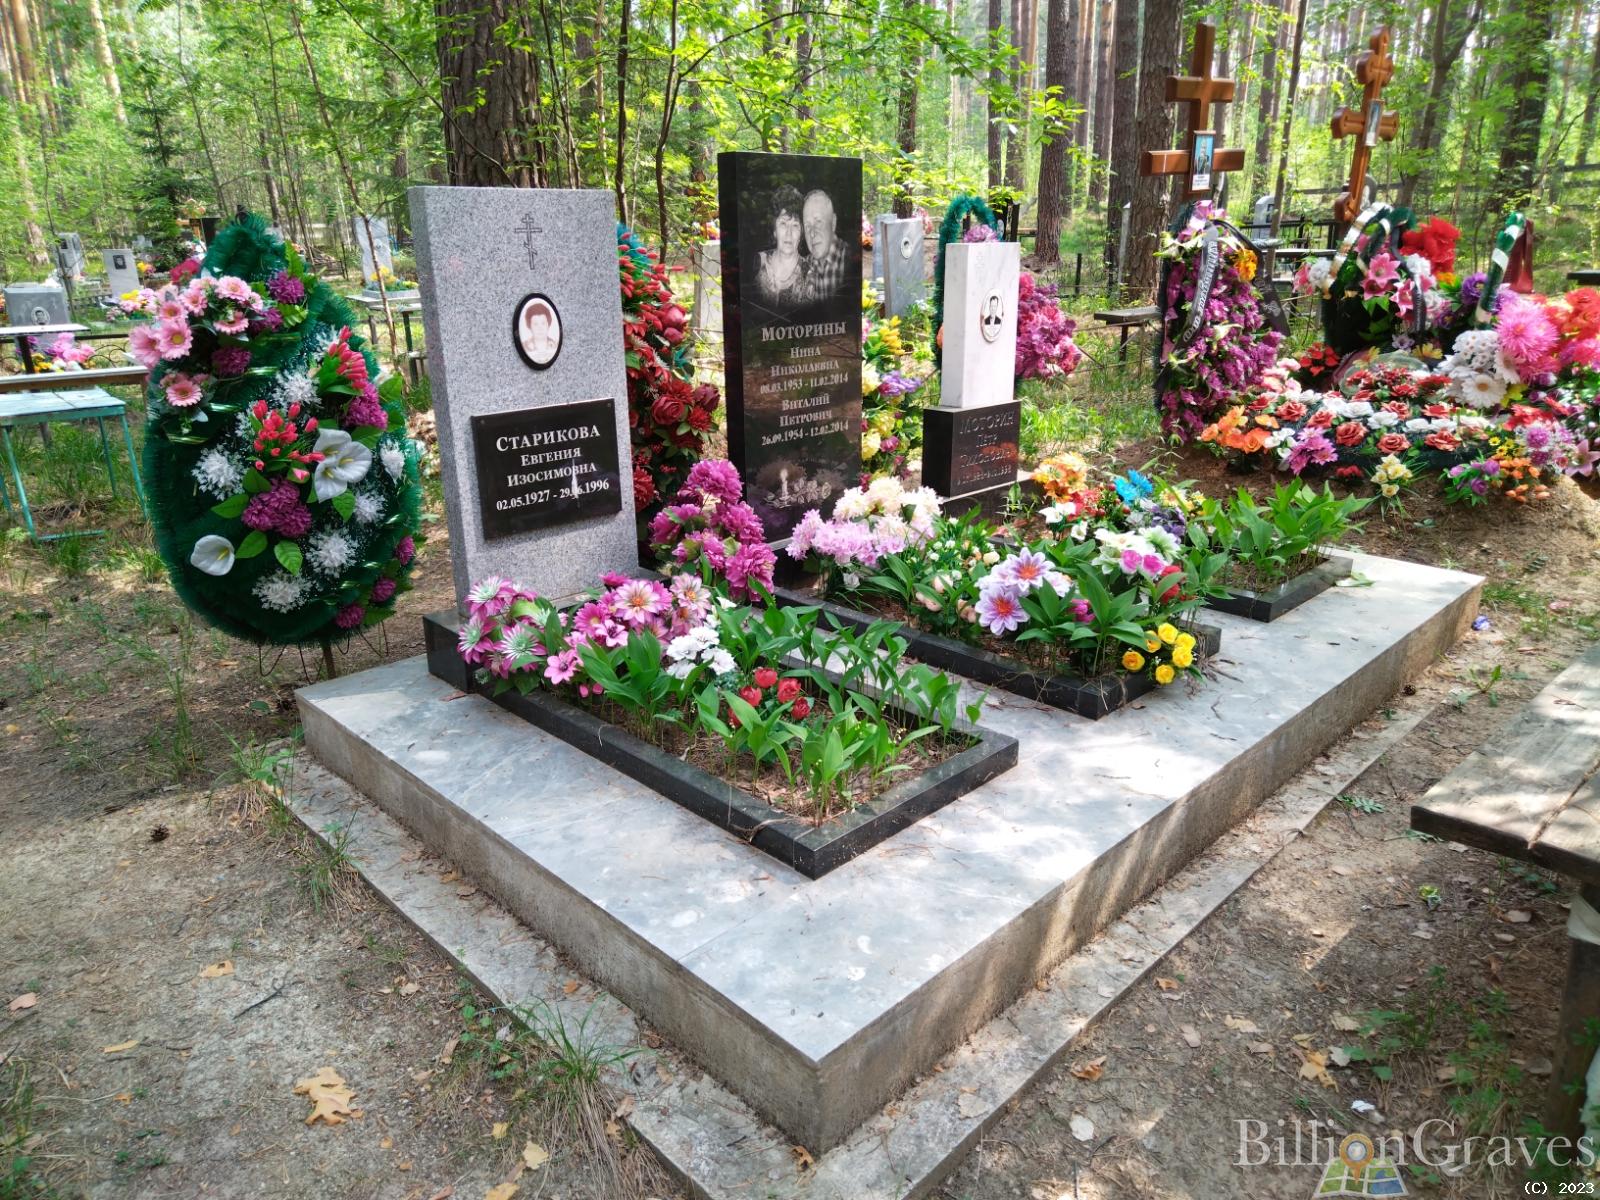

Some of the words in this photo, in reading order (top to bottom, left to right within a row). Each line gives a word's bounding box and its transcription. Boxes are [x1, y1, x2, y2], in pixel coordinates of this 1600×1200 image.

[761, 322, 847, 341] МОТОРИНЫ
[790, 346, 821, 358] НИНА
[771, 360, 840, 377] НИКОЛАЕВНА
[810, 372, 848, 388] 11.02.2014
[781, 393, 830, 411] ВИТАЛИЙ
[779, 410, 833, 427] ПЕТРОВИЧ
[496, 425, 600, 451] СТАРИКОВА
[761, 428, 803, 445] 26.09.1954
[810, 420, 849, 437] 12.02.2014
[521, 447, 582, 466] ЕВГЕНИЯ
[507, 462, 597, 487] ИЗОСИМОВНА
[496, 490, 550, 511] 02.05.1927
[559, 480, 610, 499] 29.6.1996
